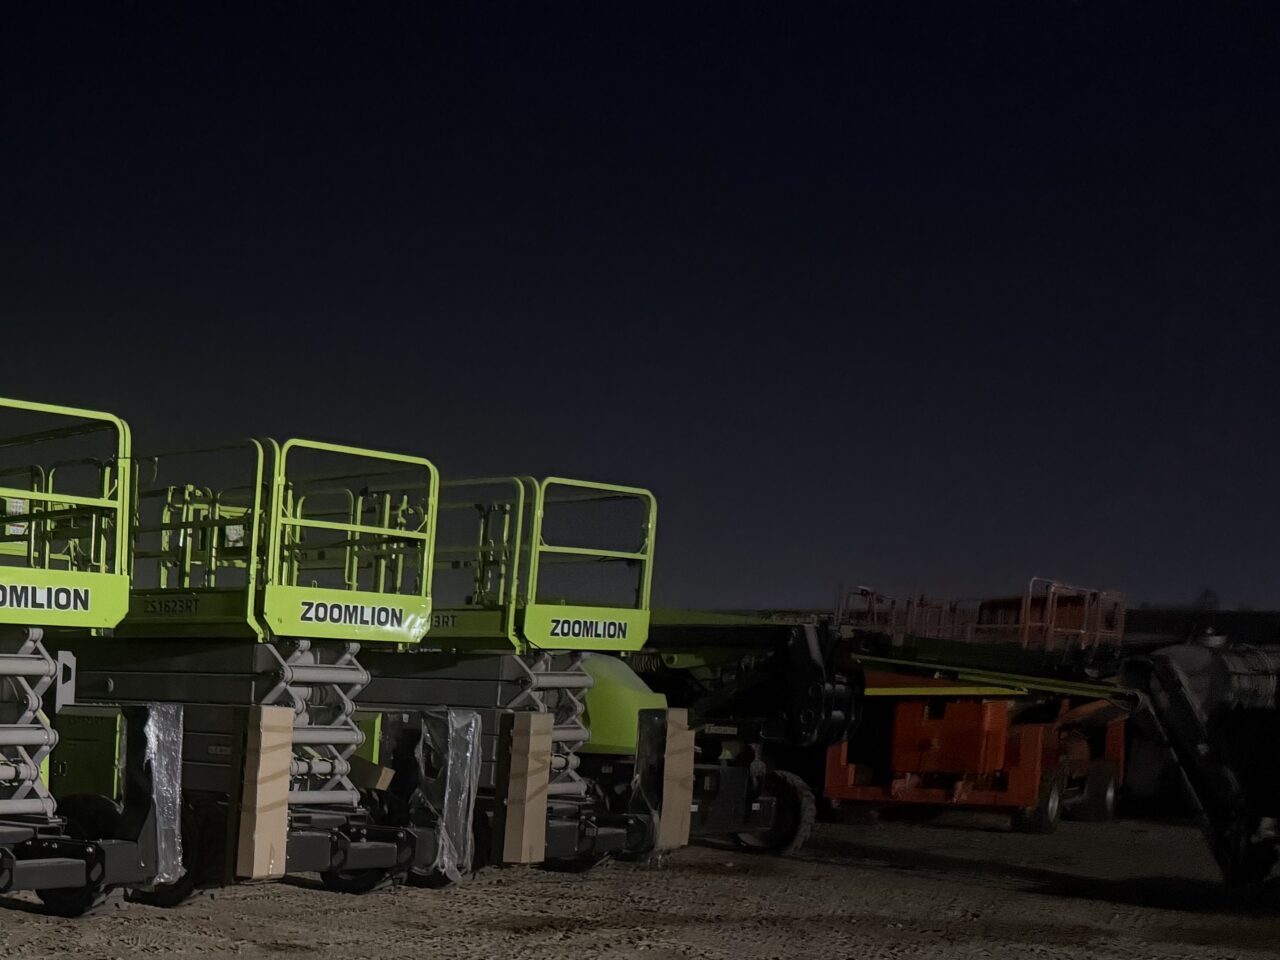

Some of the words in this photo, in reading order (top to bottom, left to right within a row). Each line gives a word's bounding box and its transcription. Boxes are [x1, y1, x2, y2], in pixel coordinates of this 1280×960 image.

[143, 599, 200, 614] ZS1623RT
[300, 601, 403, 627] ZOOMLION
[550, 619, 627, 639] ZOOMLION
